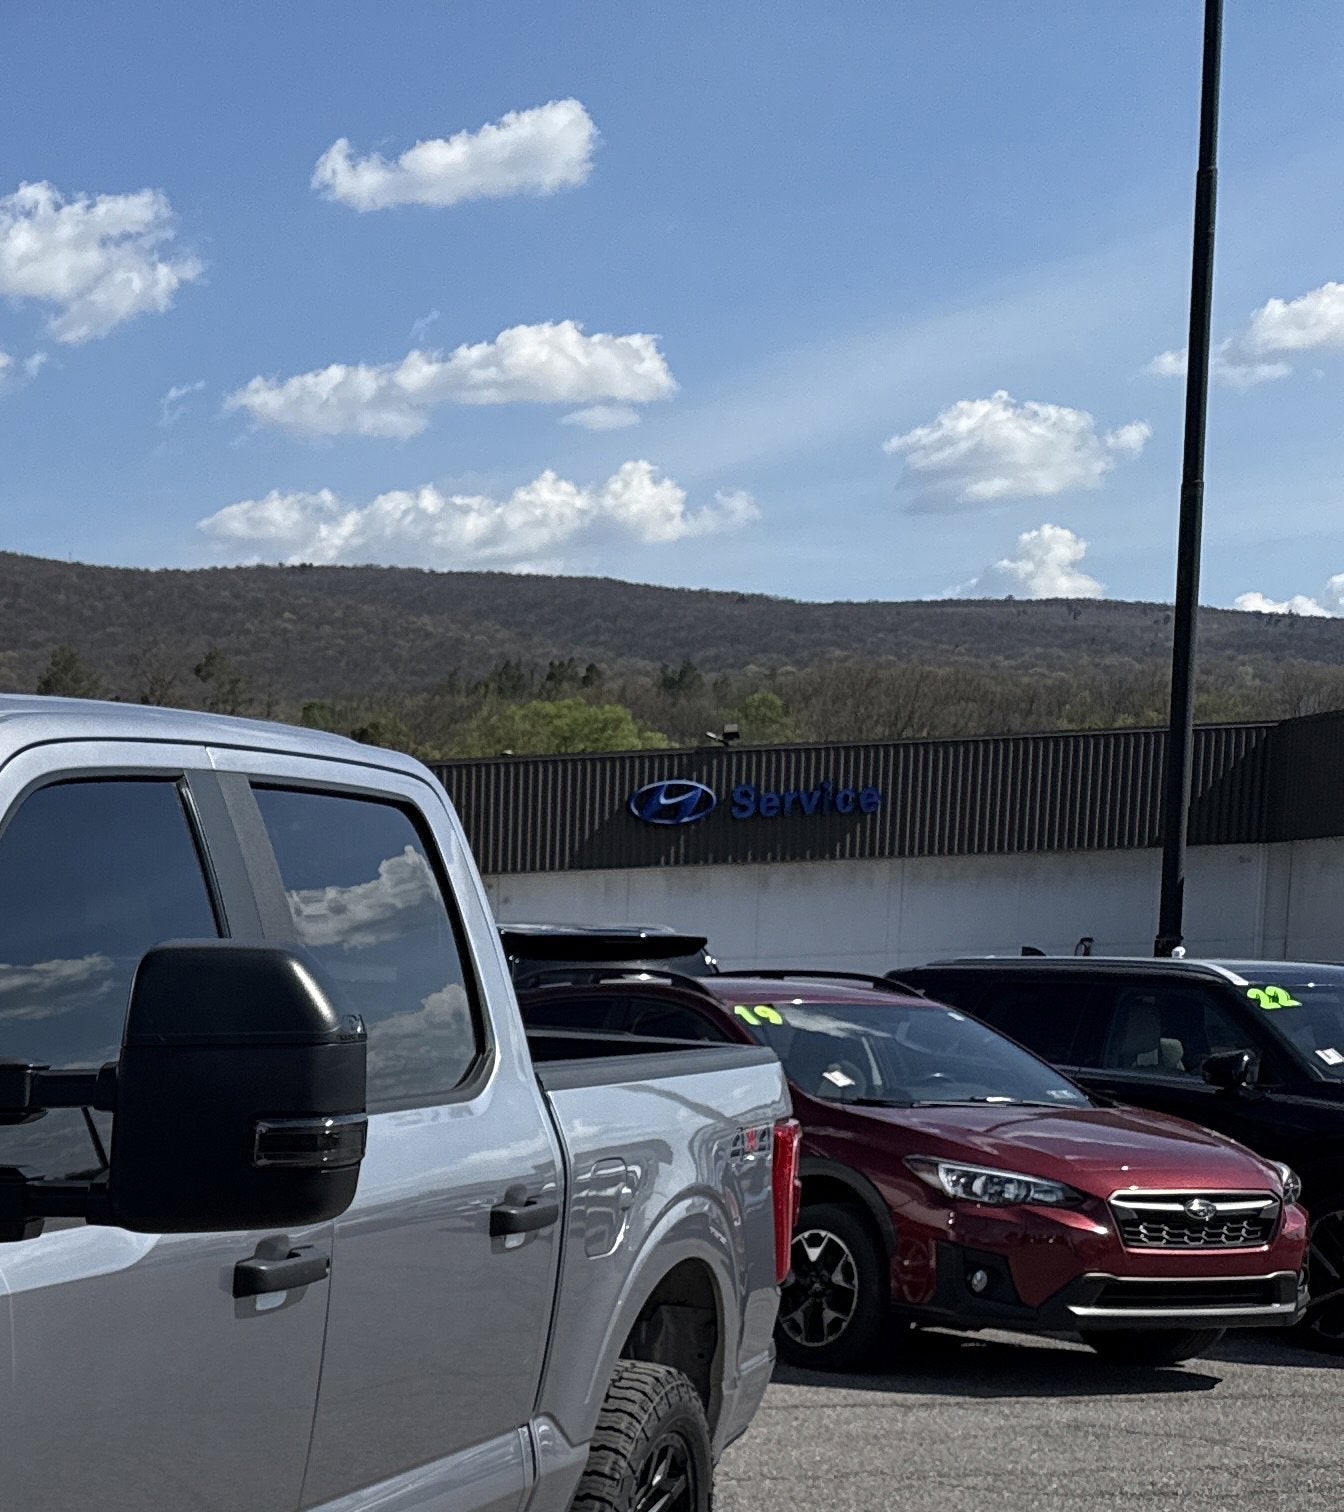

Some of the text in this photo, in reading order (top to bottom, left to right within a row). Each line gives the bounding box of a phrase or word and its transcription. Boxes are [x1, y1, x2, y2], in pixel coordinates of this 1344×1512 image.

[730, 779, 881, 820] Service
[1246, 985, 1303, 1010] 22
[734, 1005, 783, 1026] 19
